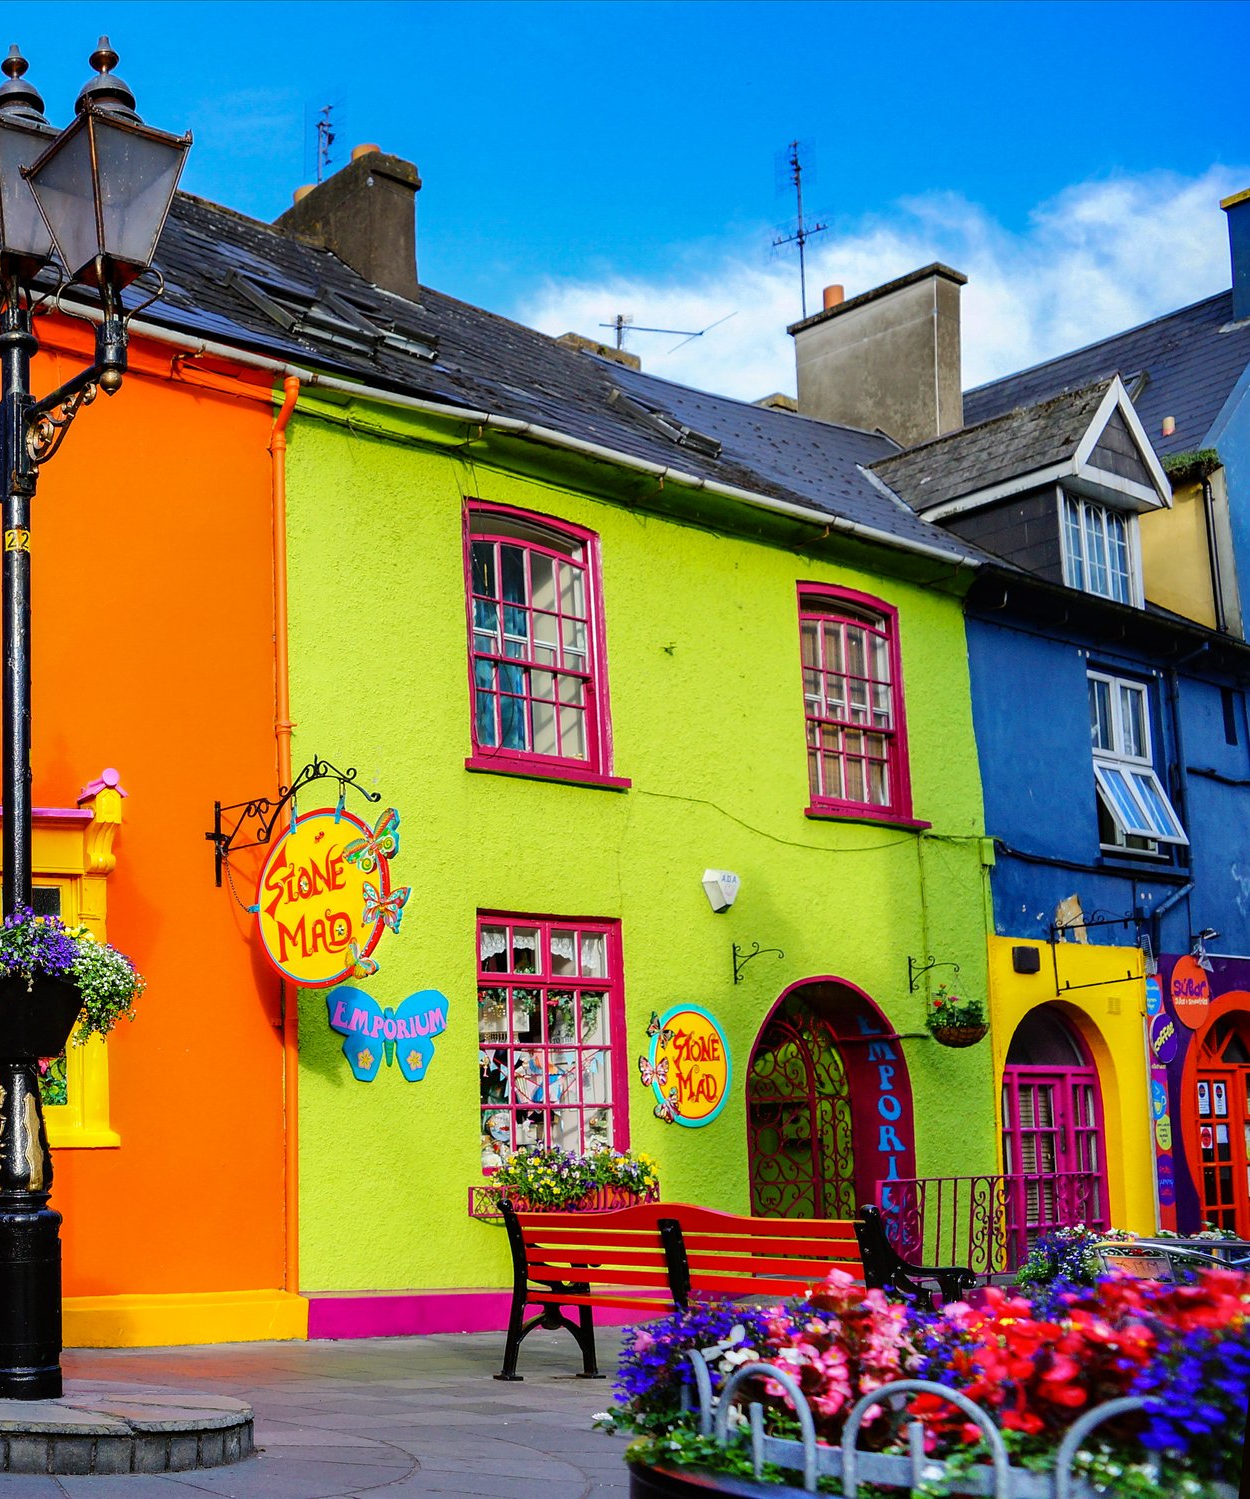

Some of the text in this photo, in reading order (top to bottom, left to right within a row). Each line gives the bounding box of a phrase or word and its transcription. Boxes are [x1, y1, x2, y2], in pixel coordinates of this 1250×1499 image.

[7, 532, 29, 549] 22
[264, 840, 347, 920] STONE
[276, 909, 353, 963] MAD
[331, 1000, 447, 1040] EMPORIUM
[672, 1028, 720, 1075] STONE
[675, 1065, 718, 1104] MAD
